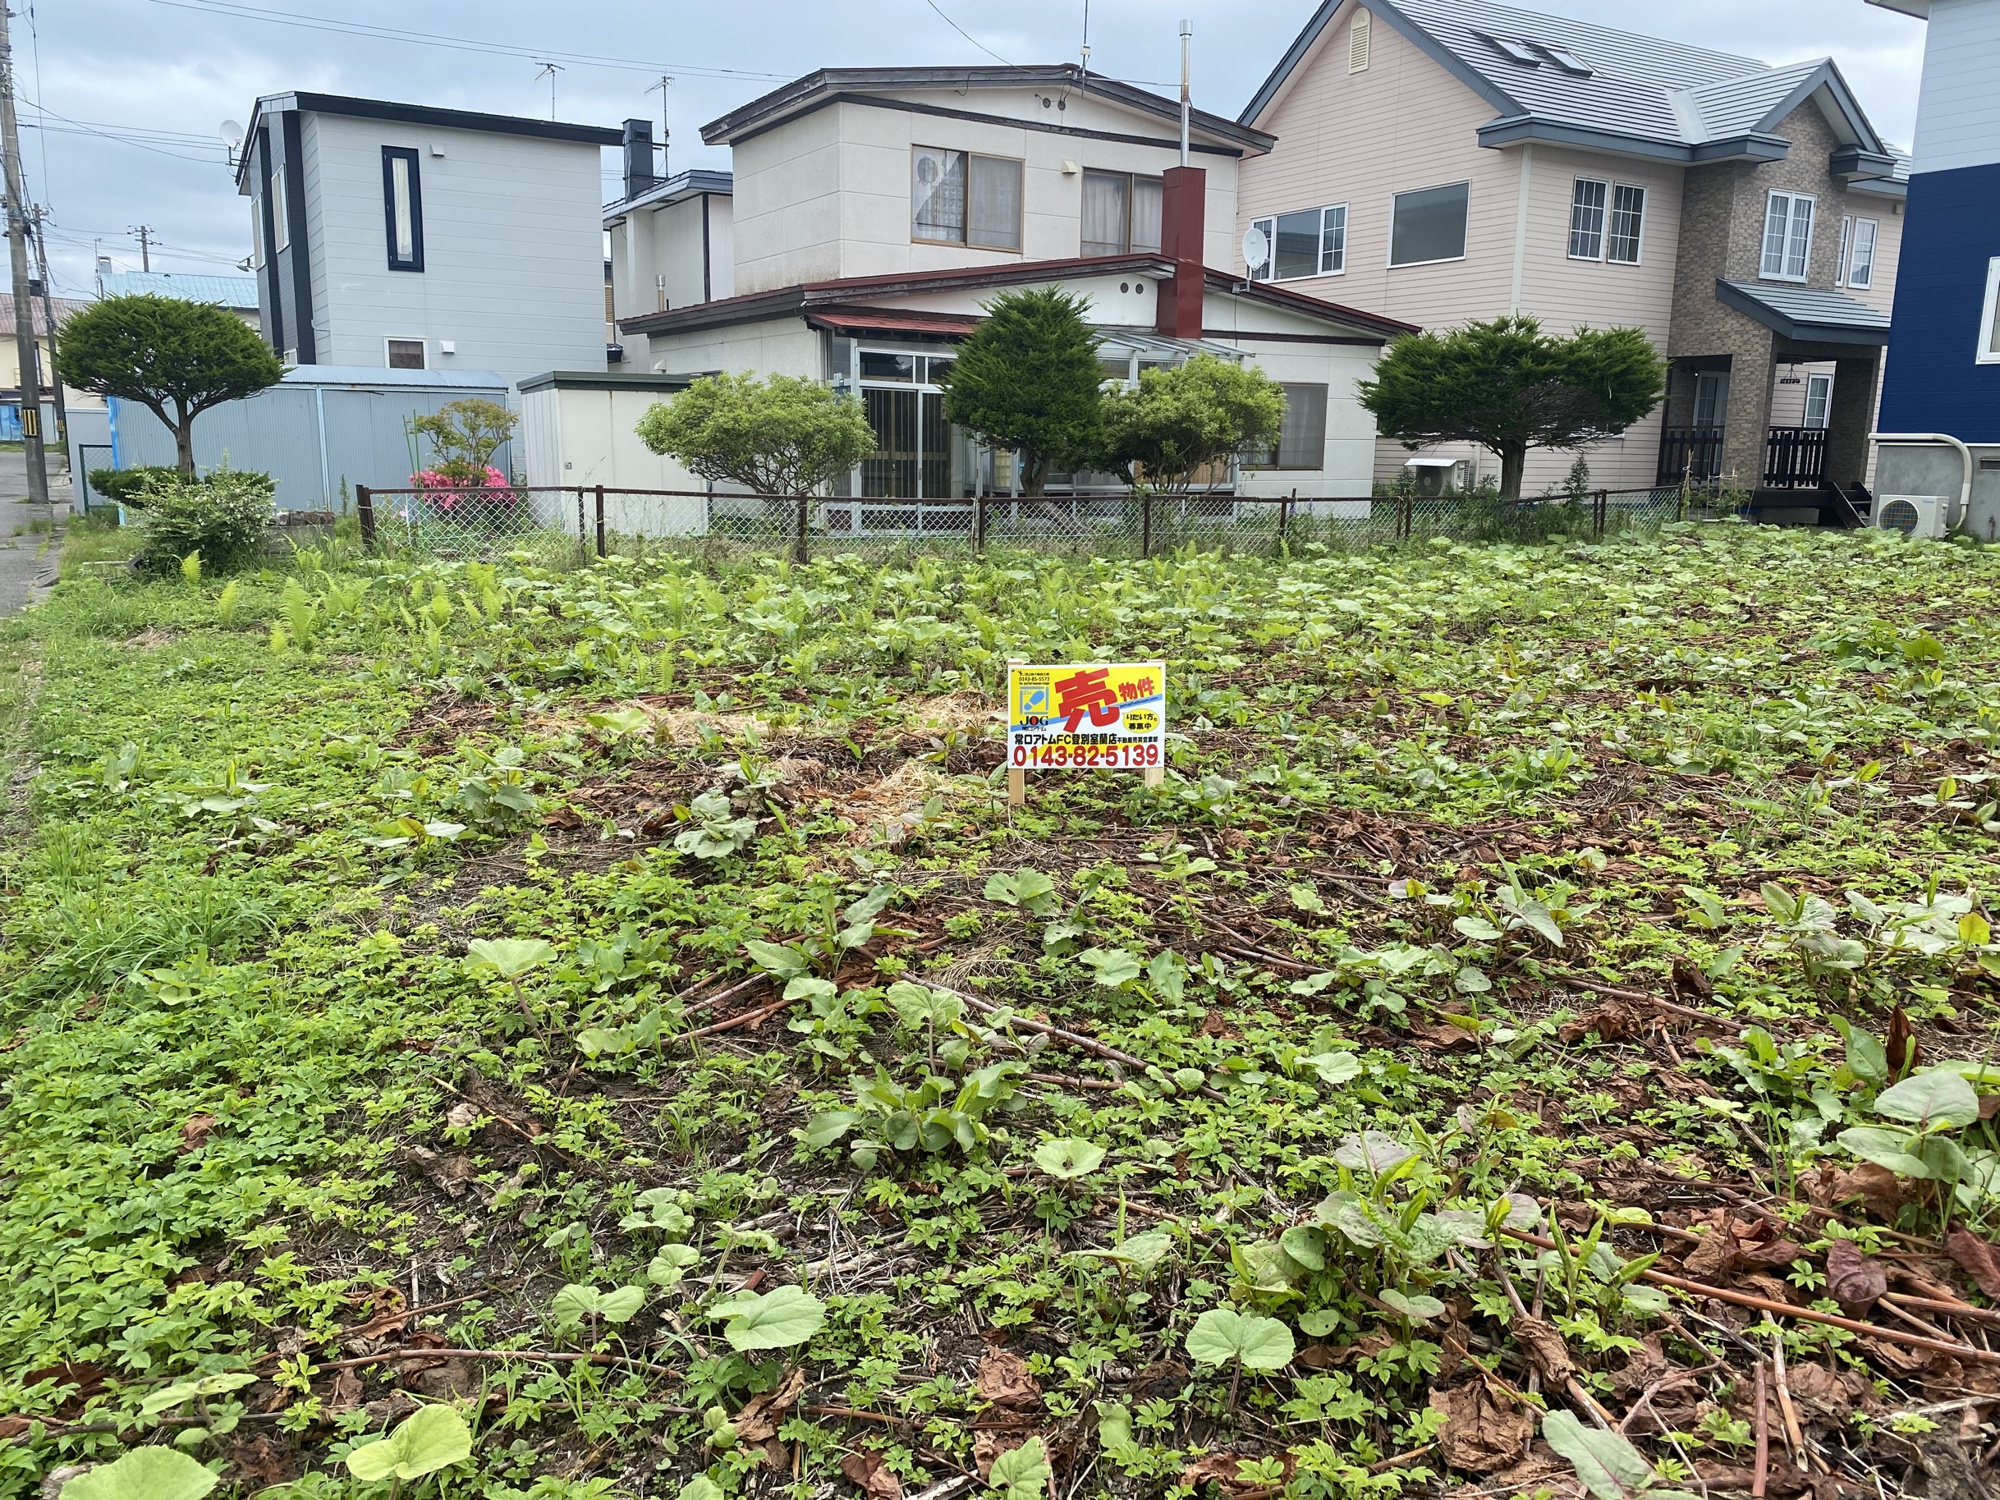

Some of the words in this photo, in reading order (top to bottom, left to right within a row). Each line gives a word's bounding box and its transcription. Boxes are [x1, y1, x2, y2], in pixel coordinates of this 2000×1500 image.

[1055, 668, 1120, 733] 売
[1119, 677, 1155, 702] 物件
[1020, 716, 1048, 726] JOG
[1013, 744, 1159, 767] 0143-82-5139
